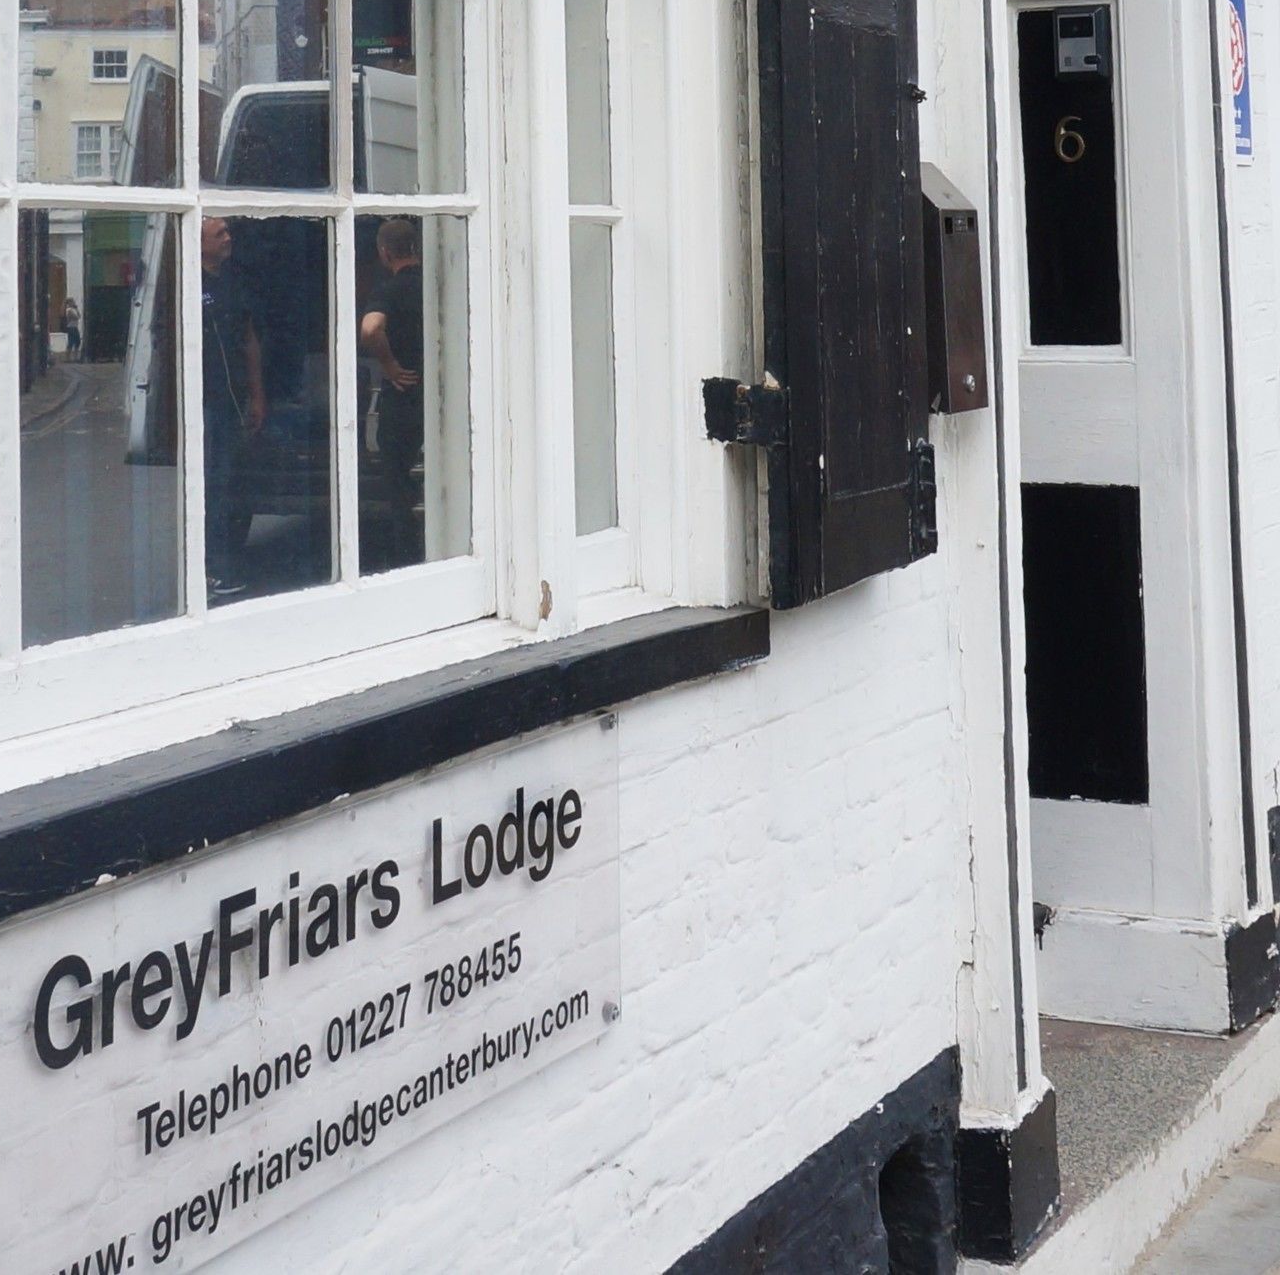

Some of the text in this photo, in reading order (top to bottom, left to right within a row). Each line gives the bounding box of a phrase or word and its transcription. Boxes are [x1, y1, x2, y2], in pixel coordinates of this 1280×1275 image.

[1055, 115, 1085, 162] 6
[33, 787, 583, 1070] GreyFriars Lodge
[137, 932, 523, 1156] Telephone 01227 788455
[152, 989, 590, 1264] greyfriarslodgecanterbury.com
